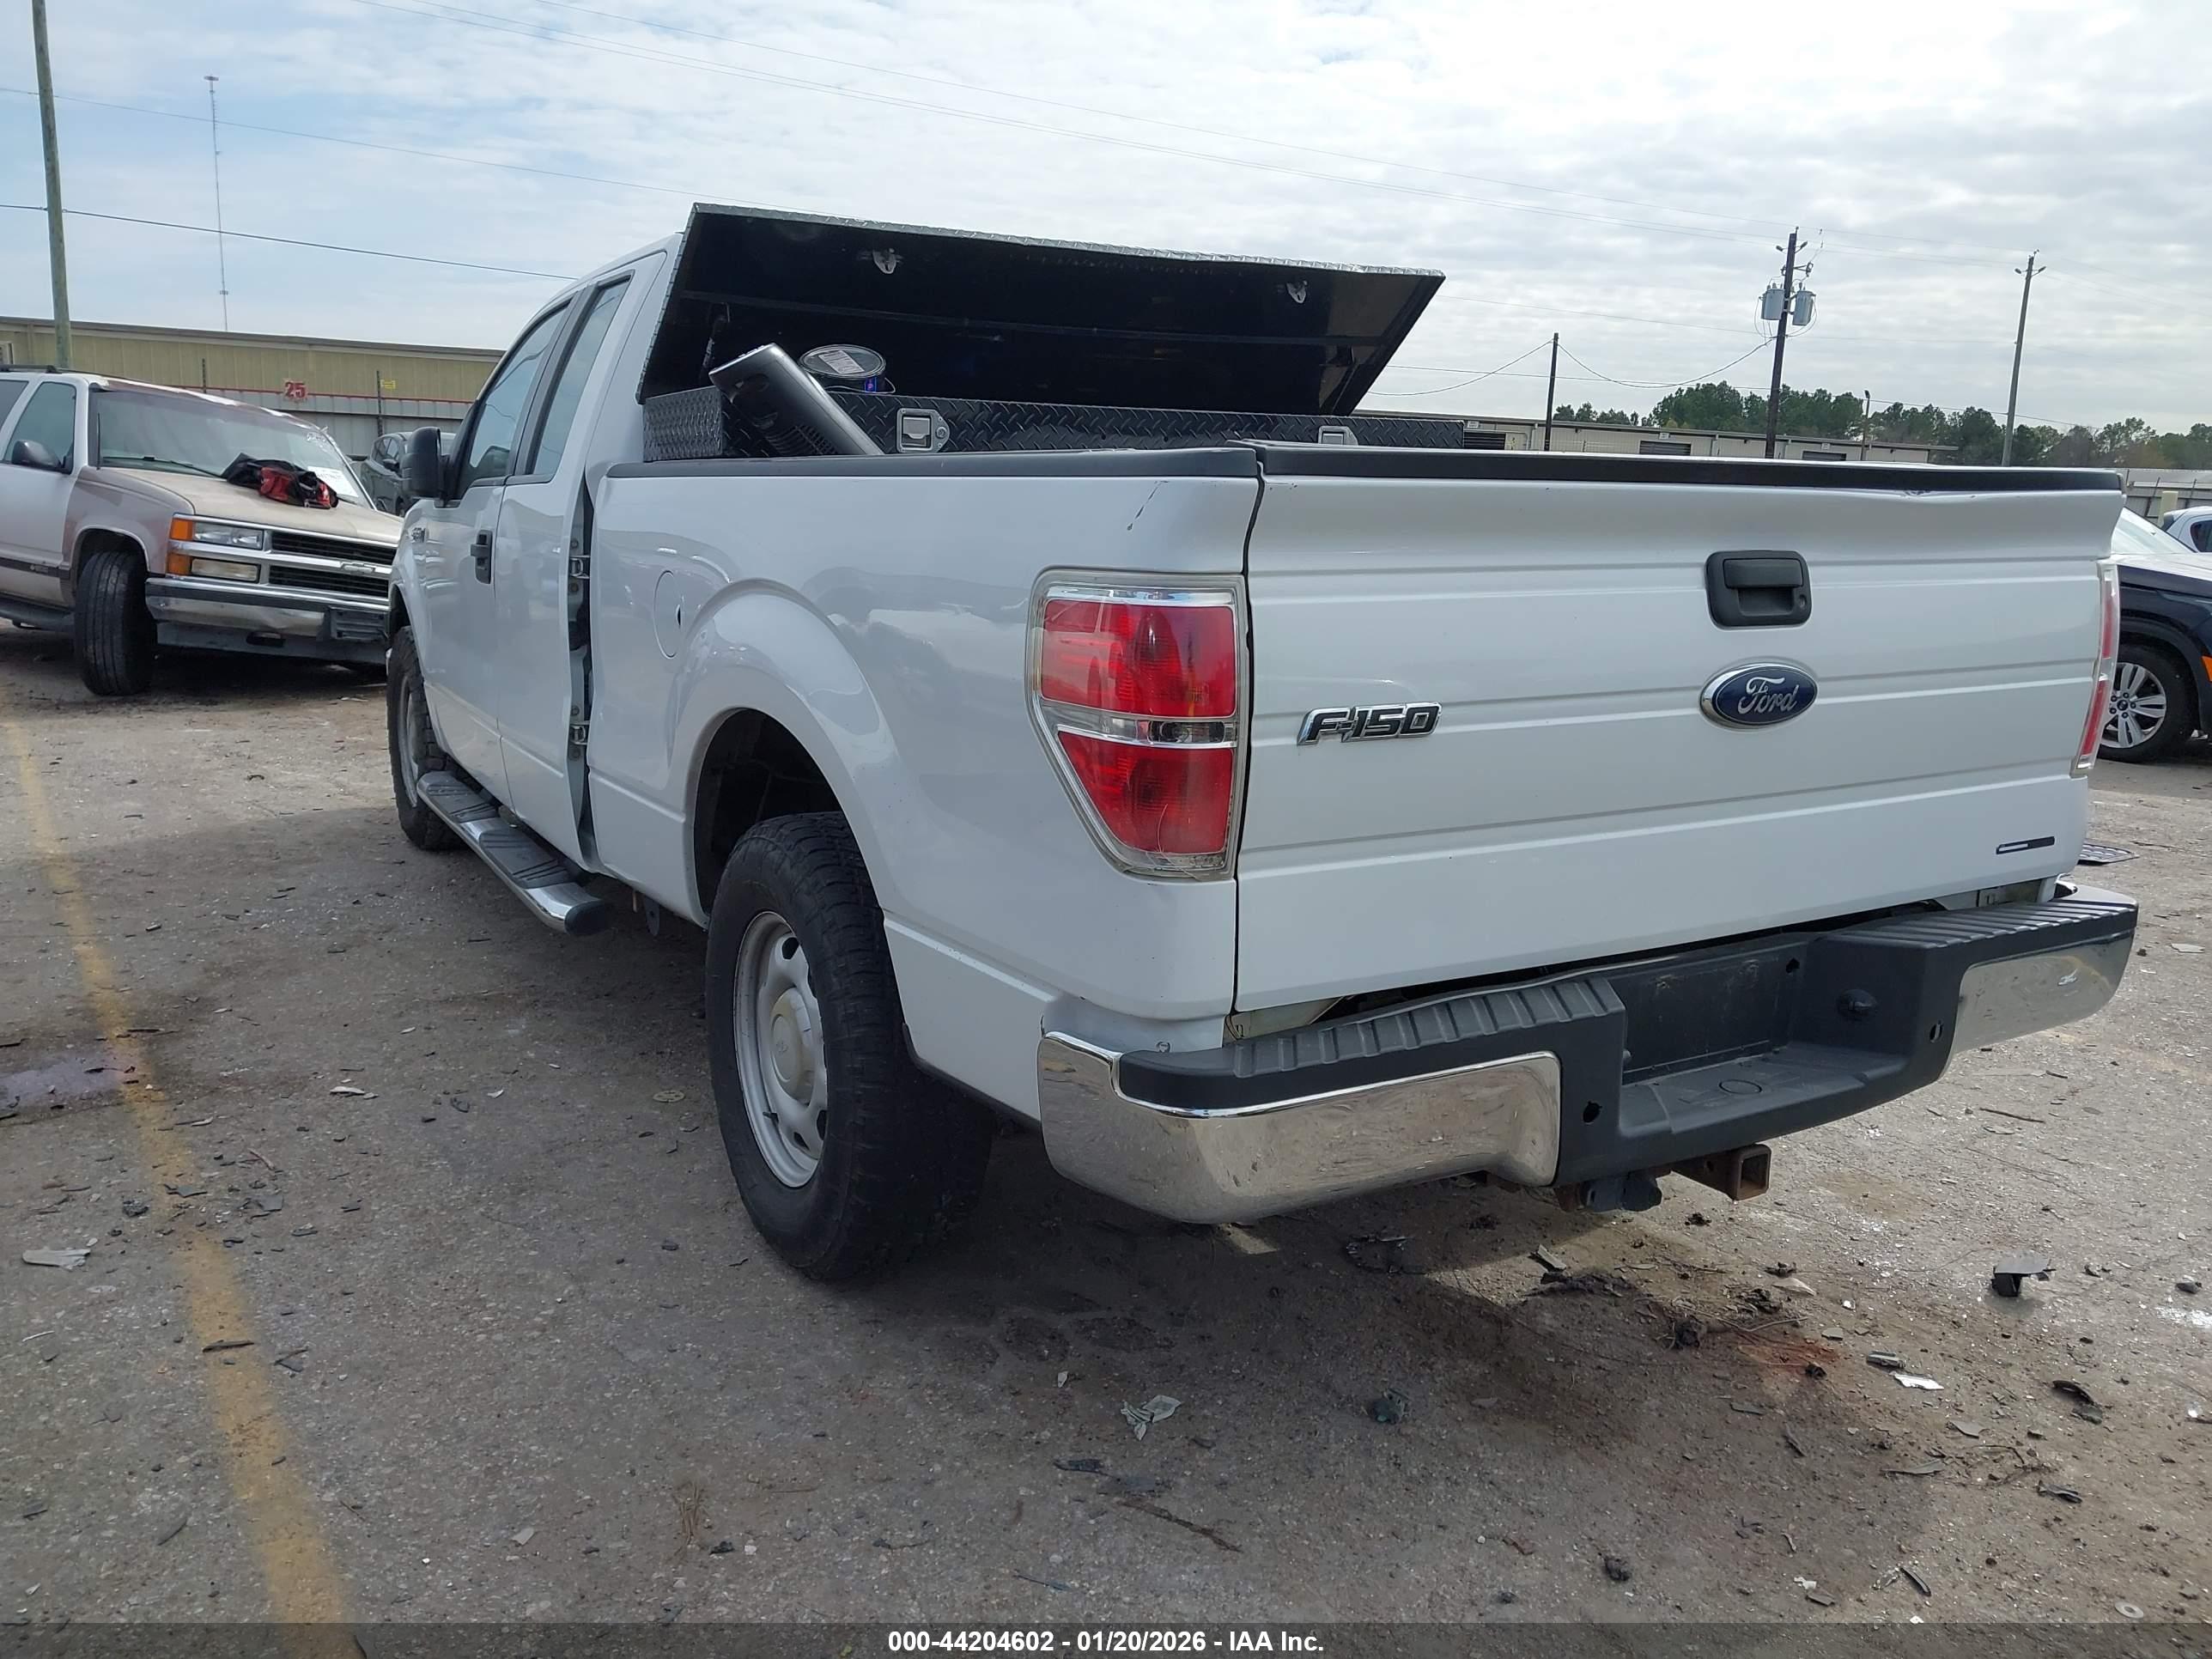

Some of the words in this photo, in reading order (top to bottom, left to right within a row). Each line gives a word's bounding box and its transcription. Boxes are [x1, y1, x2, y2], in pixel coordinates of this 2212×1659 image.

[285, 381, 306, 398] 25
[1737, 677, 1800, 714] Ford
[1297, 702, 1443, 745] F-150
